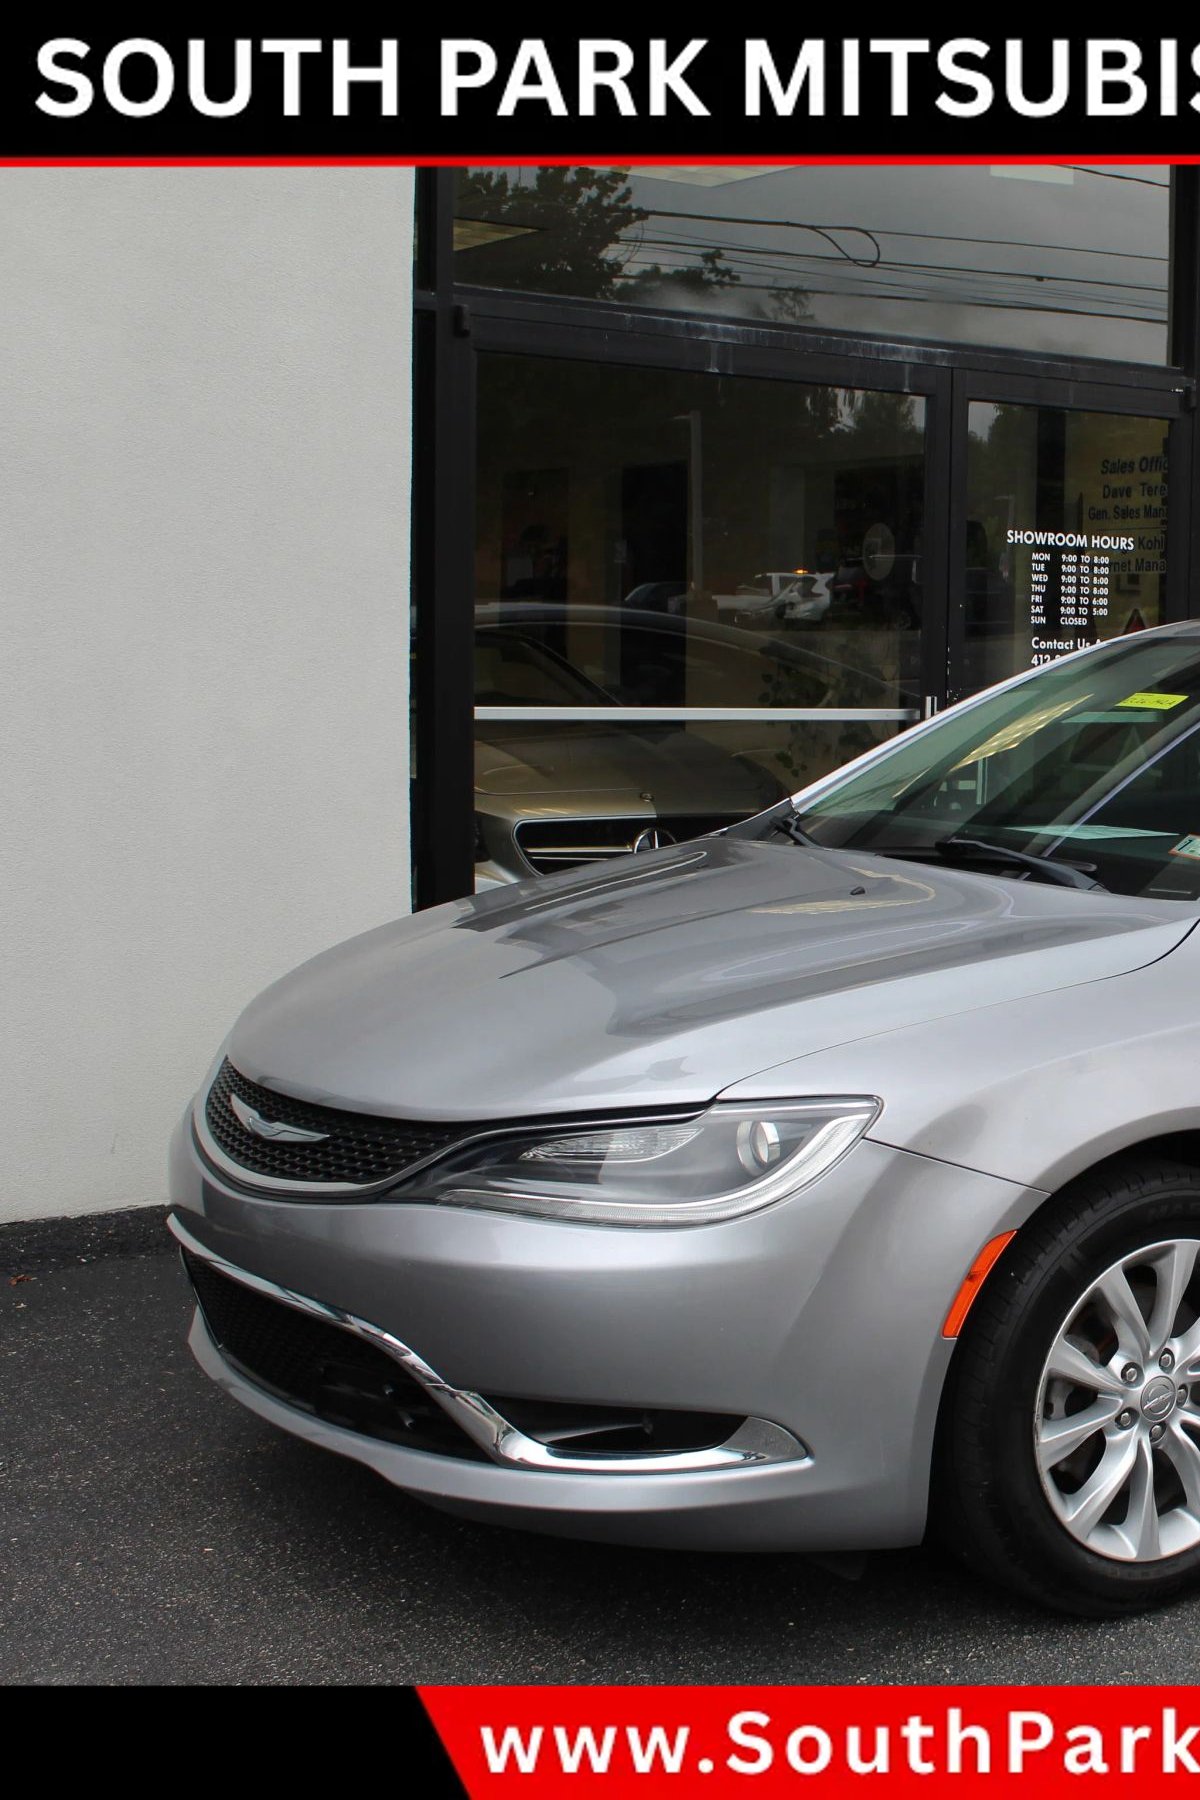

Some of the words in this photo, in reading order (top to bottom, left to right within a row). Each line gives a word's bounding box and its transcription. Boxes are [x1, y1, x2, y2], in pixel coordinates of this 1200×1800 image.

[1101, 458, 1136, 475] Sales
[1103, 484, 1132, 499] Dave
[1139, 482, 1168, 497] Tere
[1113, 505, 1140, 520] Sales
[1007, 530, 1088, 548] SHOWROOM
[1091, 535, 1134, 550] HOURS
[1031, 552, 1051, 561] MON
[1061, 554, 1077, 563] 9:00
[1080, 555, 1091, 564] TO
[1093, 556, 1110, 565] 8:00
[1031, 563, 1045, 572] TUE
[1061, 565, 1077, 573] 9:00
[1080, 566, 1090, 574] TO
[1093, 567, 1109, 575] 8:00
[1031, 574, 1049, 582] WED
[1061, 575, 1077, 584] 9:00
[1080, 576, 1090, 585] TO
[1093, 577, 1109, 586] 8:00
[1031, 584, 1046, 593] THU
[1060, 586, 1077, 594] 9:00
[1080, 587, 1090, 595] TO
[1093, 587, 1109, 596] 8:00
[1030, 595, 1042, 603] FRI
[1060, 596, 1076, 605] 9:00
[1079, 597, 1089, 605] TO
[1092, 598, 1108, 606] 6:00
[1030, 605, 1044, 614] SAT
[1060, 607, 1076, 615] 9:00
[1078, 607, 1088, 616] TO
[1092, 608, 1108, 616] 5:00
[1030, 616, 1046, 625] SUN
[1060, 617, 1087, 626] CLOSED
[1031, 636, 1074, 650] Contact
[1077, 638, 1091, 650] Us
